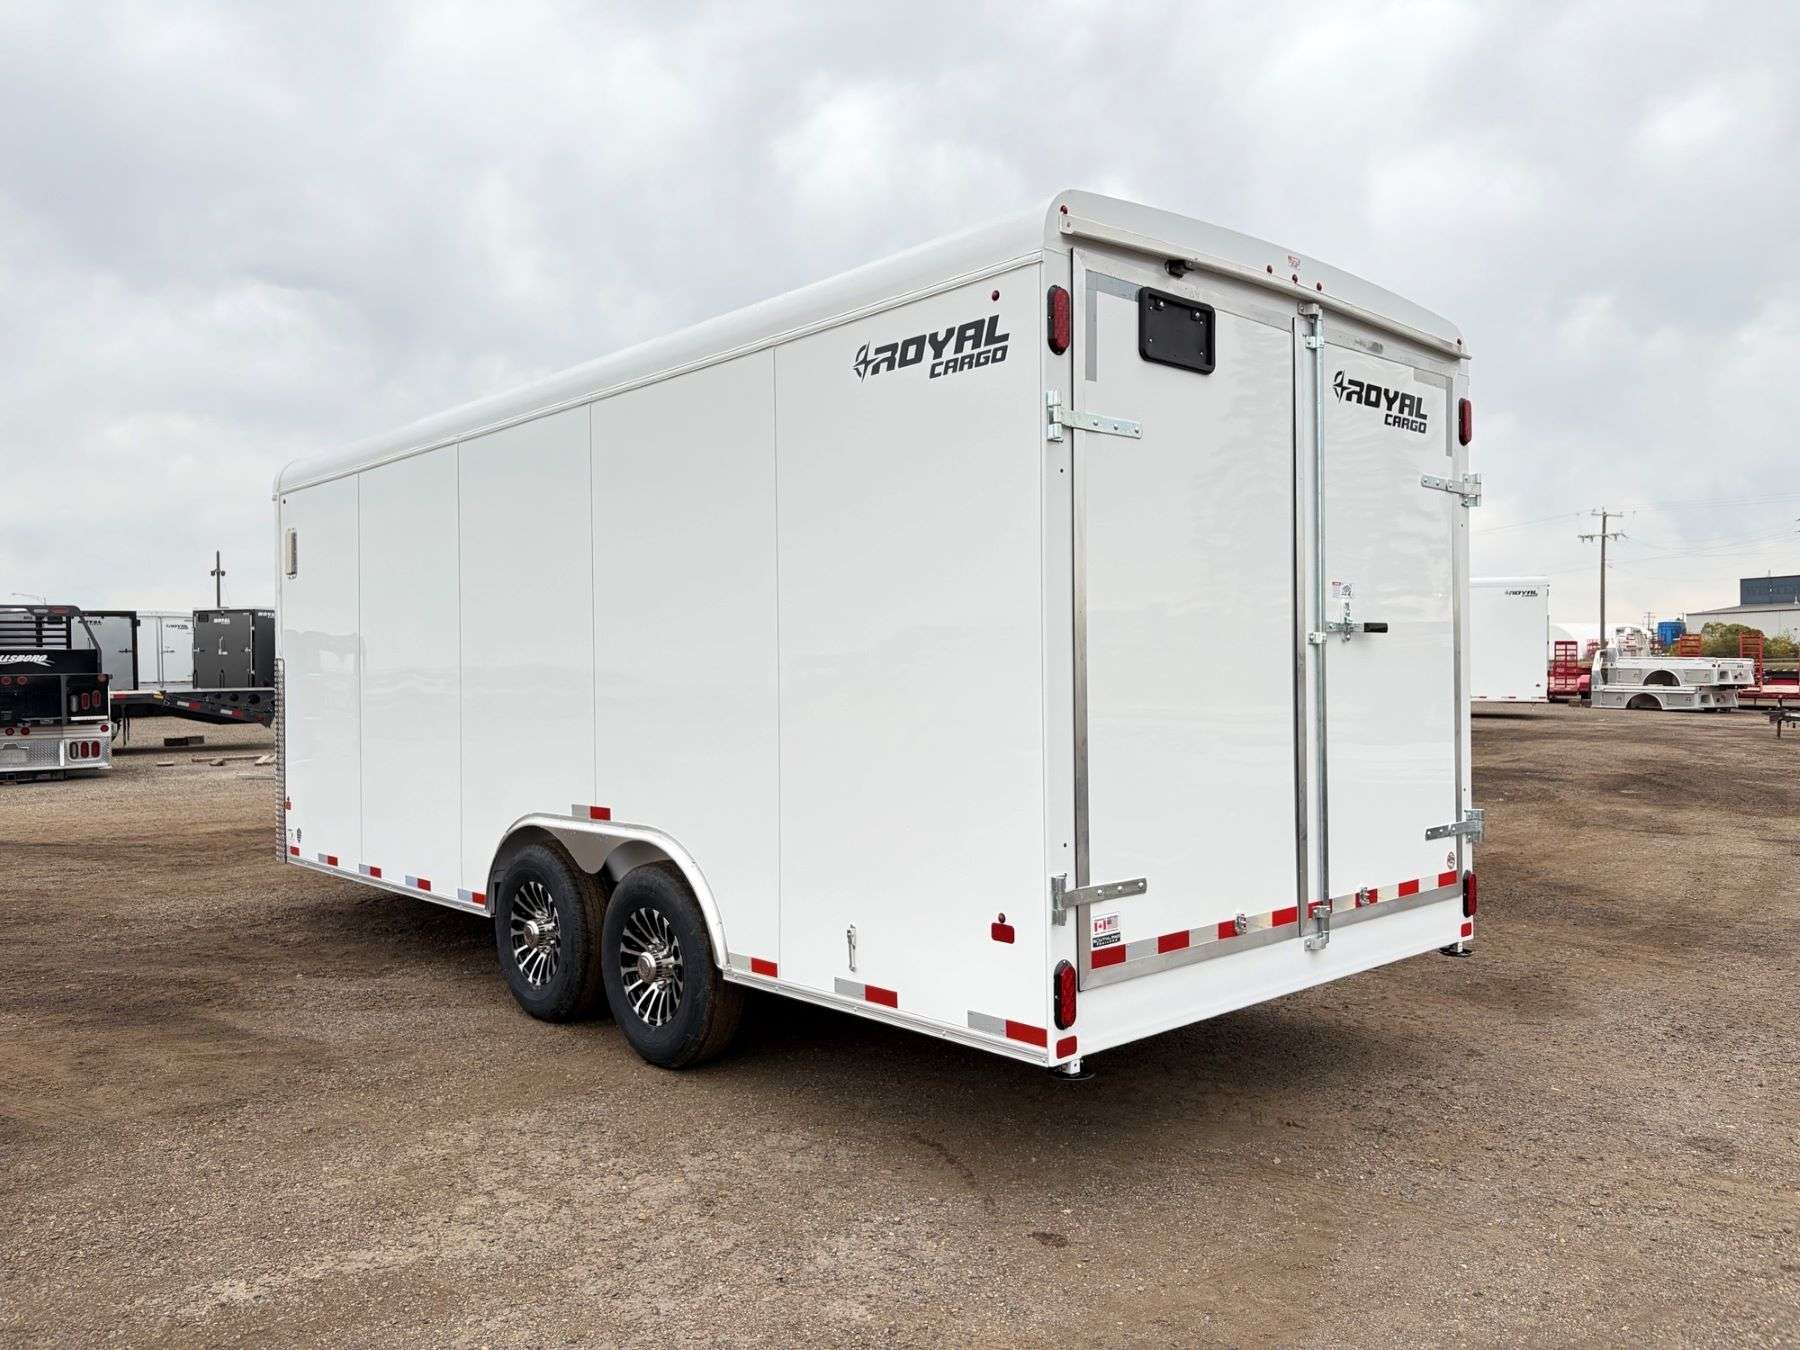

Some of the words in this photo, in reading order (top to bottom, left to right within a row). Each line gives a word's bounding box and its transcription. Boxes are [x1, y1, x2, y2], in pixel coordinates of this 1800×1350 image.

[871, 314, 1009, 376] ROYAL
[929, 345, 1009, 379] CARGO
[1345, 378, 1428, 420] ROYAL
[1384, 413, 1427, 434] CARGO
